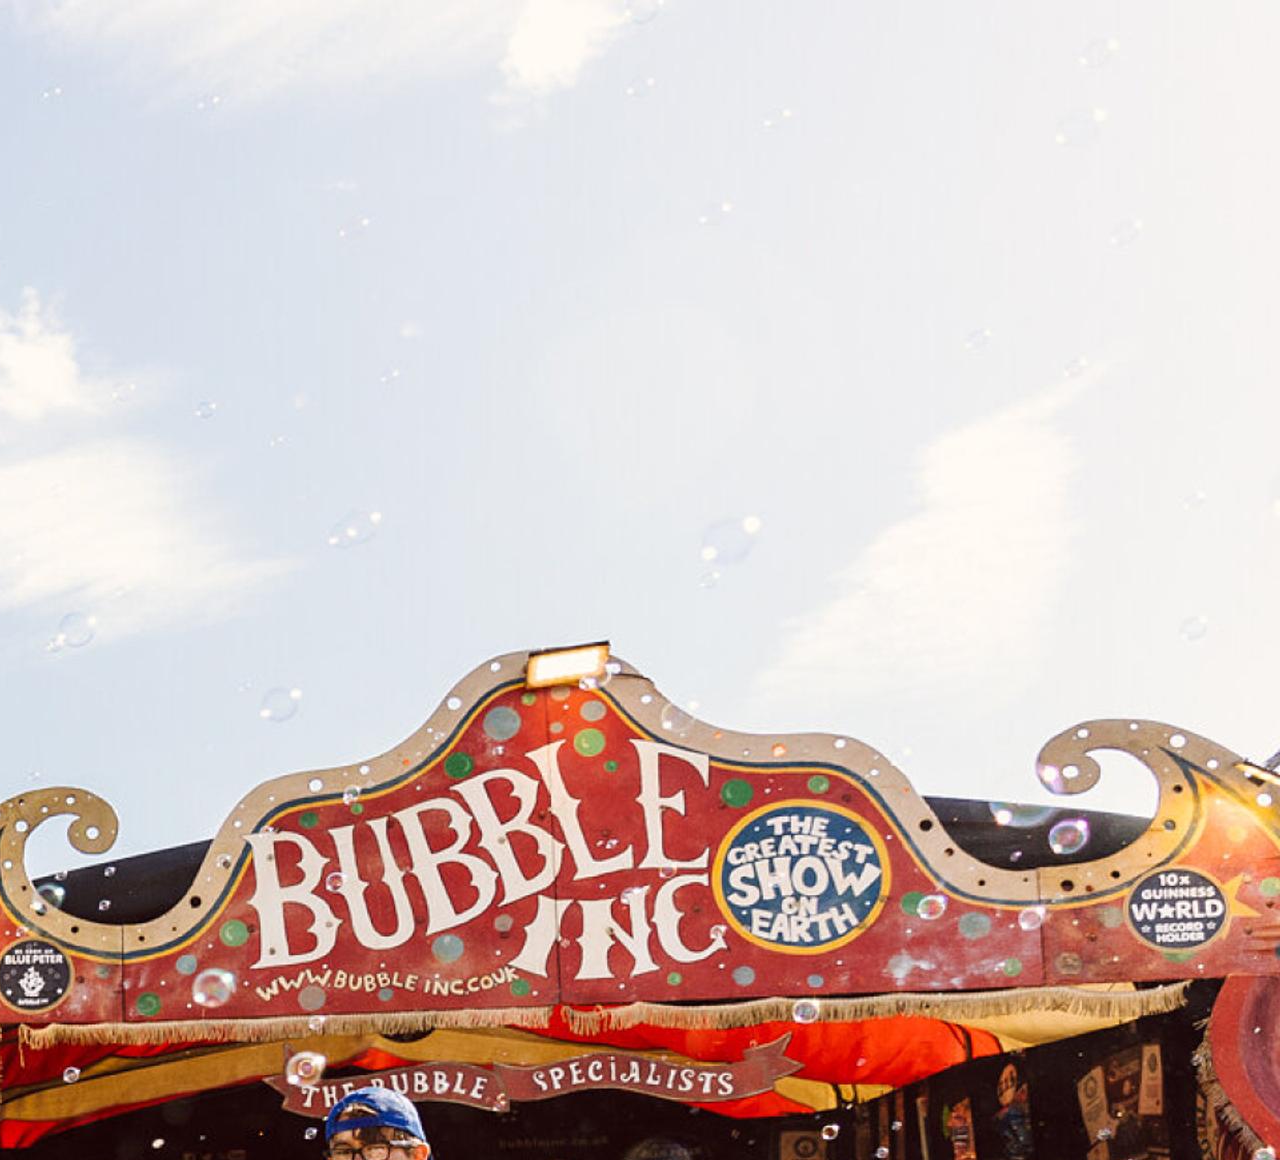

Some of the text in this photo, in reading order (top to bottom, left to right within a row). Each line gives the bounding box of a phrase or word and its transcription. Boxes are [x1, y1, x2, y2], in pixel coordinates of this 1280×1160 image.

[766, 815, 829, 838] THE
[242, 738, 711, 970] BUBBLE
[727, 834, 874, 865] GREATEST
[727, 856, 882, 907] SHOW
[1141, 885, 1216, 900] GUINNESS
[781, 896, 818, 917] ON
[509, 873, 728, 981] INC
[751, 903, 859, 942] EARTH
[1155, 922, 1204, 933] RECORD
[1155, 932, 1205, 943] HOLDER
[5, 954, 63, 965] BLUE PETER
